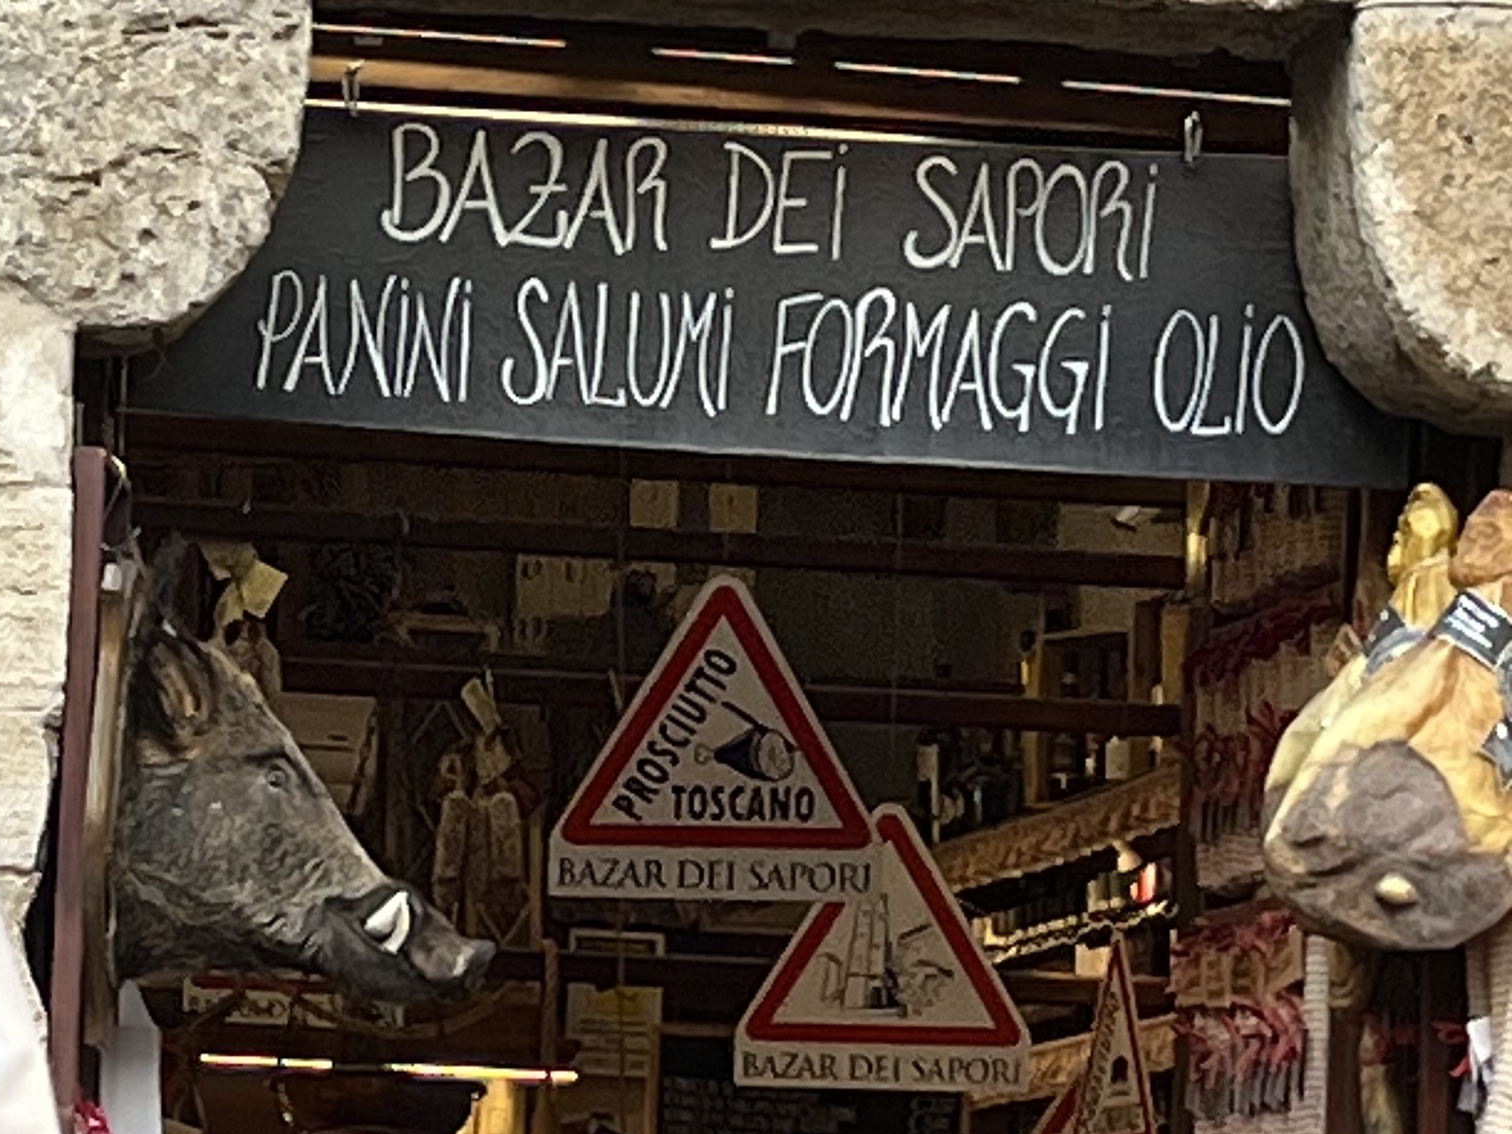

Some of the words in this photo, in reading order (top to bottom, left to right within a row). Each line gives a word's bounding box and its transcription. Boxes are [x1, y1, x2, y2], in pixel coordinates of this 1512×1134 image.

[381, 122, 669, 256] BAZAR
[611, 648, 738, 821] PROSCIUTTO
[671, 784, 816, 823] TOSCANO
[557, 856, 668, 889] BAZAR
[676, 859, 735, 892] DEI
[747, 860, 872, 894] SAPORI
[741, 1050, 839, 1081] BAZAR
[848, 1053, 901, 1083] DEI
[909, 1055, 1022, 1085] SAPORI
